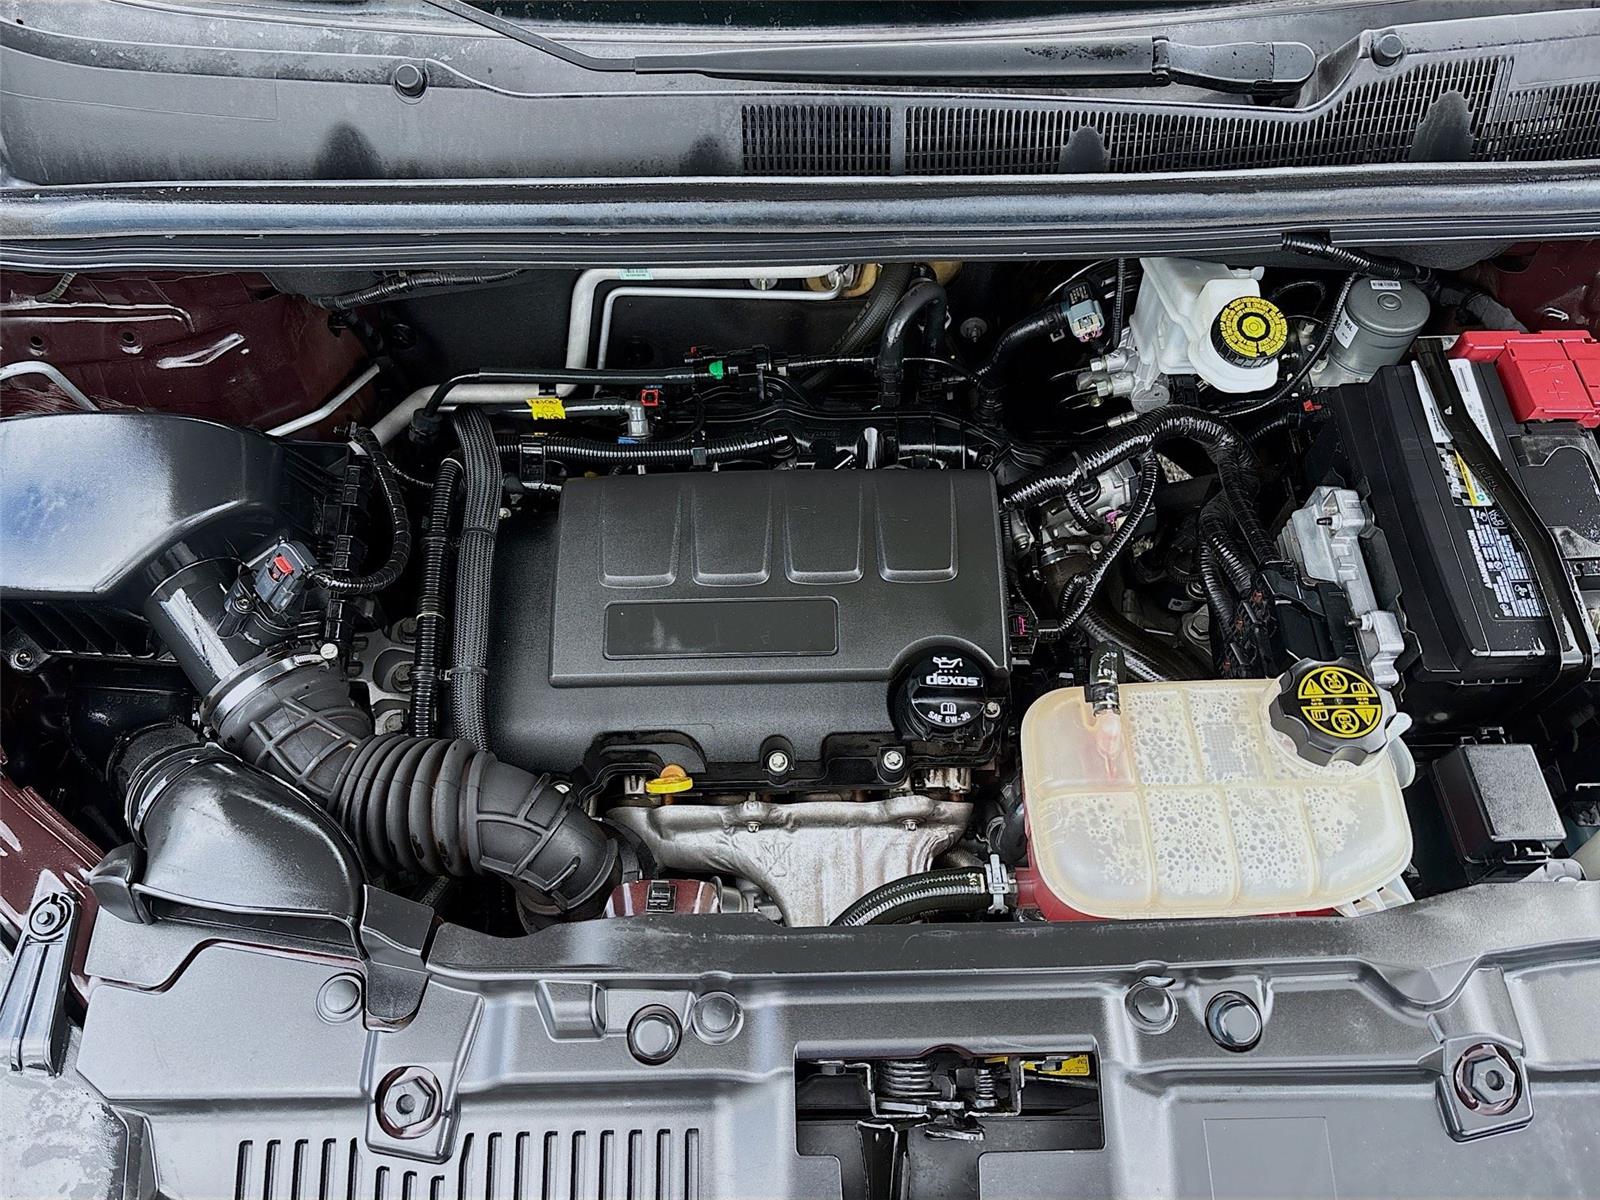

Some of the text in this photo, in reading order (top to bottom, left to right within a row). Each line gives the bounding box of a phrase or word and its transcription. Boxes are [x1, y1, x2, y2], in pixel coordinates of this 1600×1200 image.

[926, 673, 979, 686] dexos
[928, 711, 971, 723] SAE 5W-30
